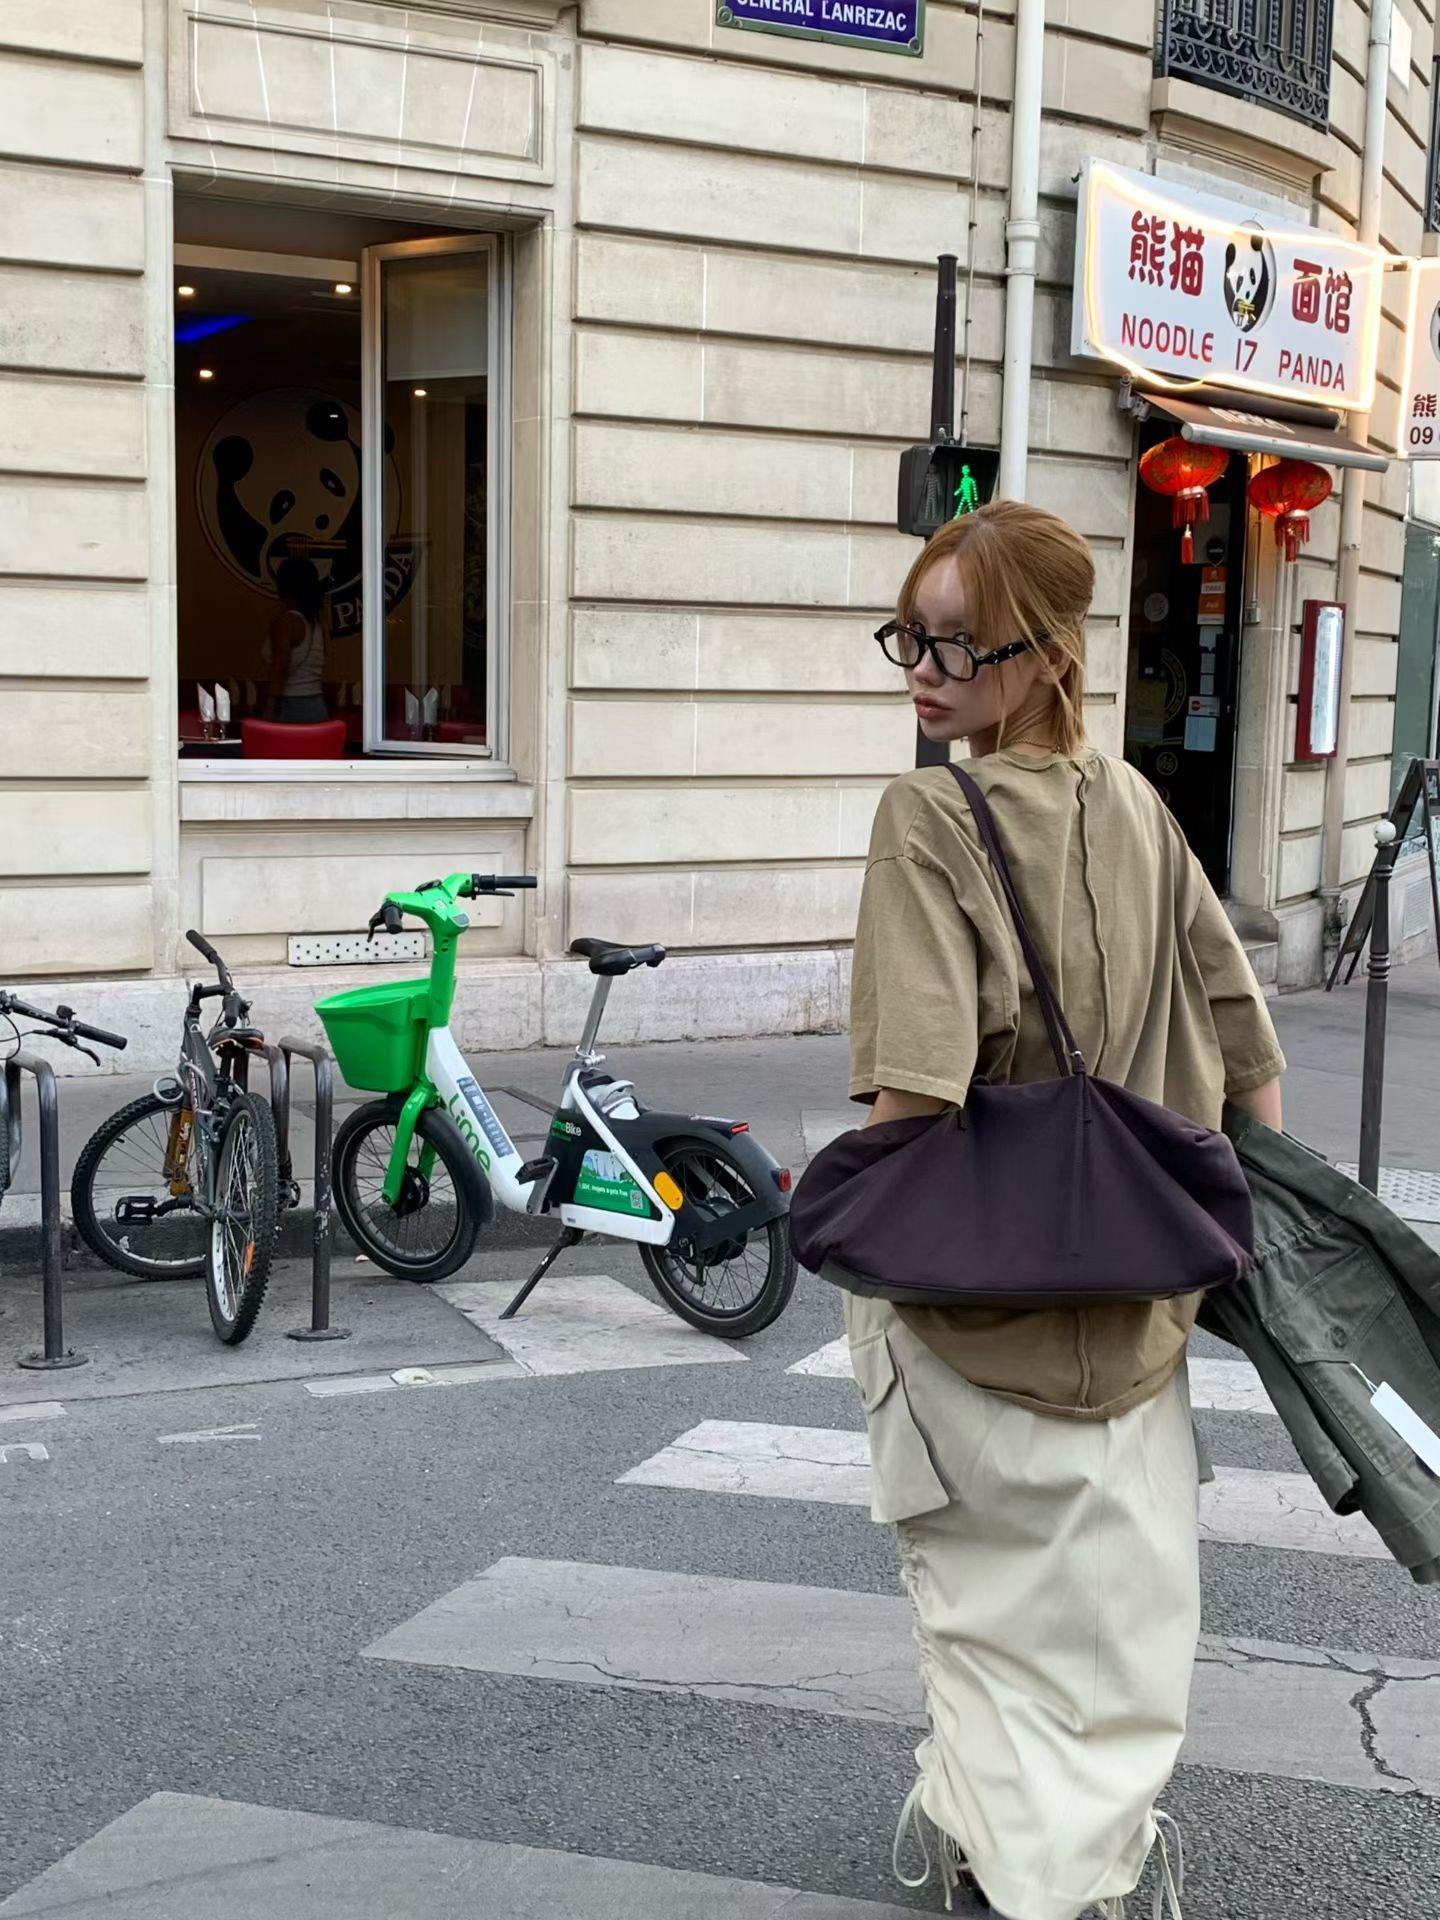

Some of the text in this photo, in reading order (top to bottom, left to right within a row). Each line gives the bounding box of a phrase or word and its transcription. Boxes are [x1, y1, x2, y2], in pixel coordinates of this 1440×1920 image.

[822, 1, 906, 32] LANREZAC
[1128, 210, 1353, 334] 熊猫 面馆
[1121, 313, 1345, 391] NOODLE 17 PANDA
[1412, 393, 1437, 418] 熊
[1409, 426, 1433, 445] 09
[449, 1093, 491, 1173] Lime
